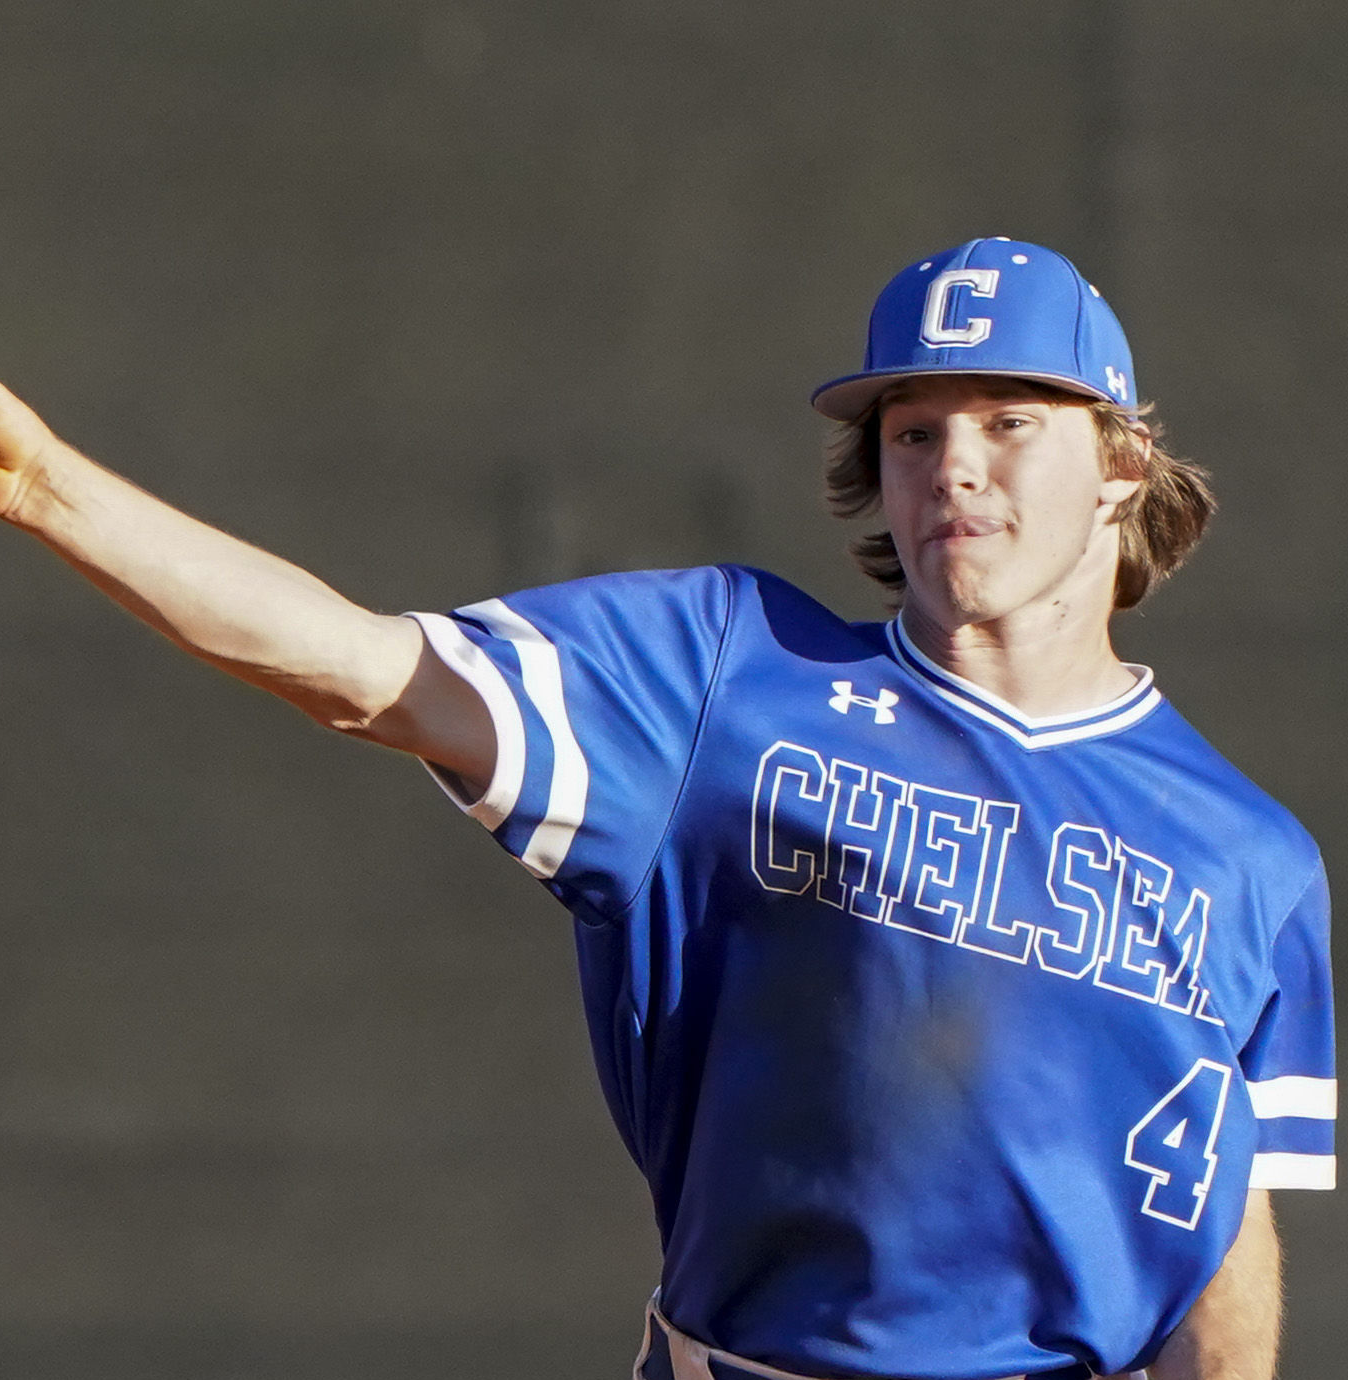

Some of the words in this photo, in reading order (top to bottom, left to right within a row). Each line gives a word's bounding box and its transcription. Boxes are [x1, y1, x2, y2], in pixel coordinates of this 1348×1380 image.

[919, 268, 1000, 349] C
[751, 740, 1225, 1027] CHELSEA
[1124, 1057, 1232, 1231] 4
